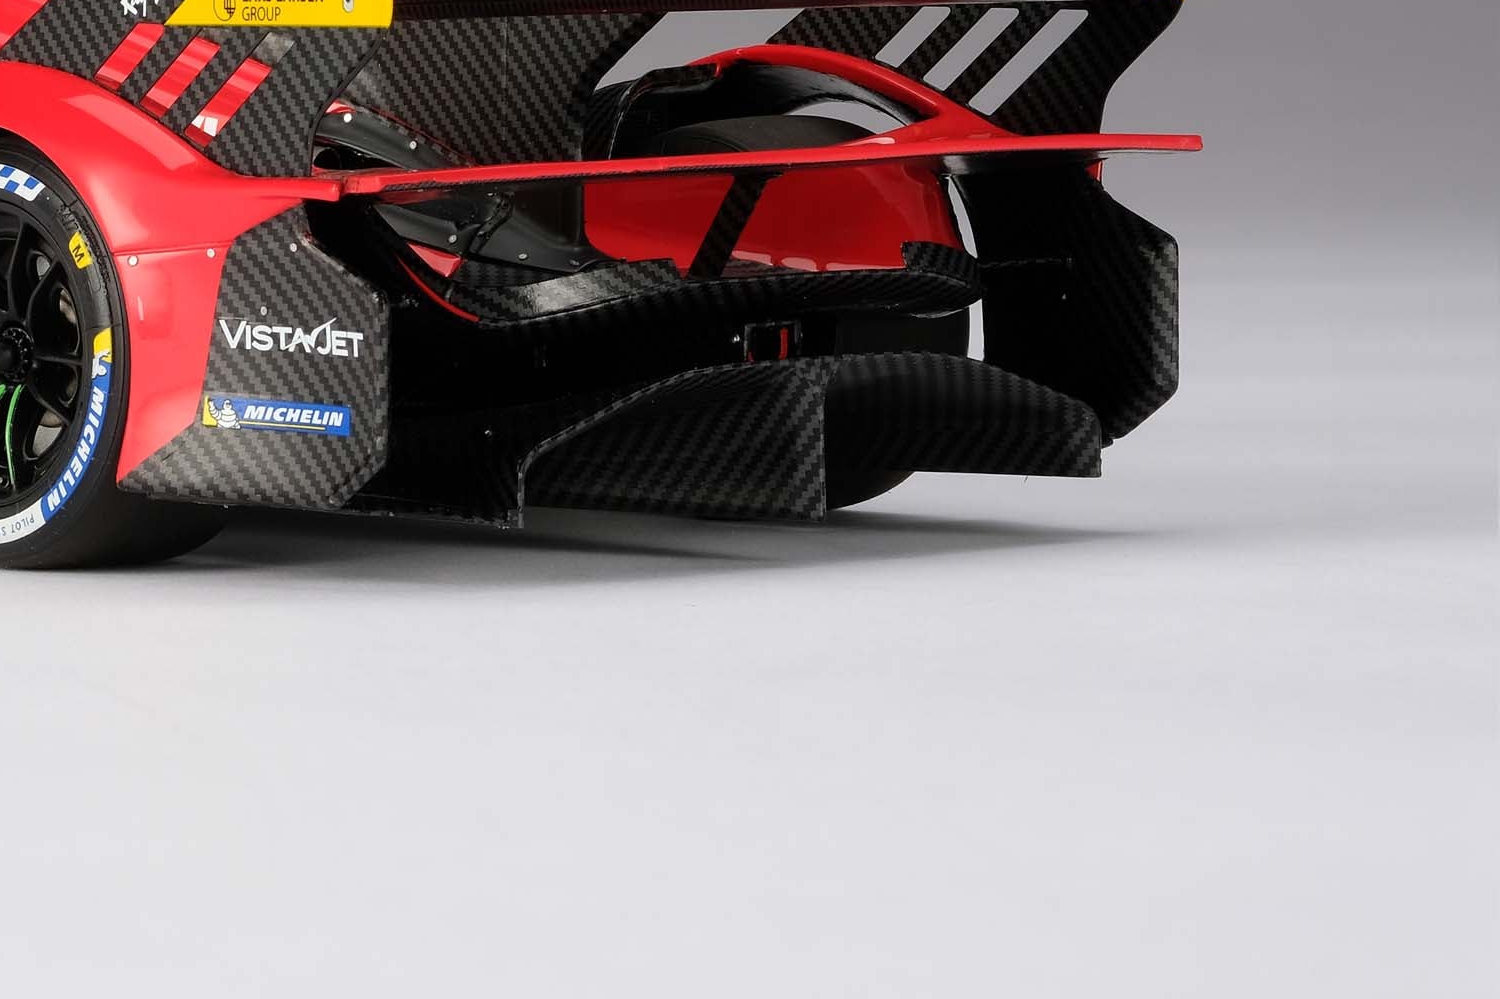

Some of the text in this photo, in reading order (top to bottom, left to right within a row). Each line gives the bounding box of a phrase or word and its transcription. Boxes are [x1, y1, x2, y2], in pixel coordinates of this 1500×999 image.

[242, 7, 282, 22] GROUP
[72, 245, 85, 263] M
[243, 405, 344, 427] MICHELIN
[47, 385, 105, 512] MICHELIN
[11, 513, 35, 534] PILOT
